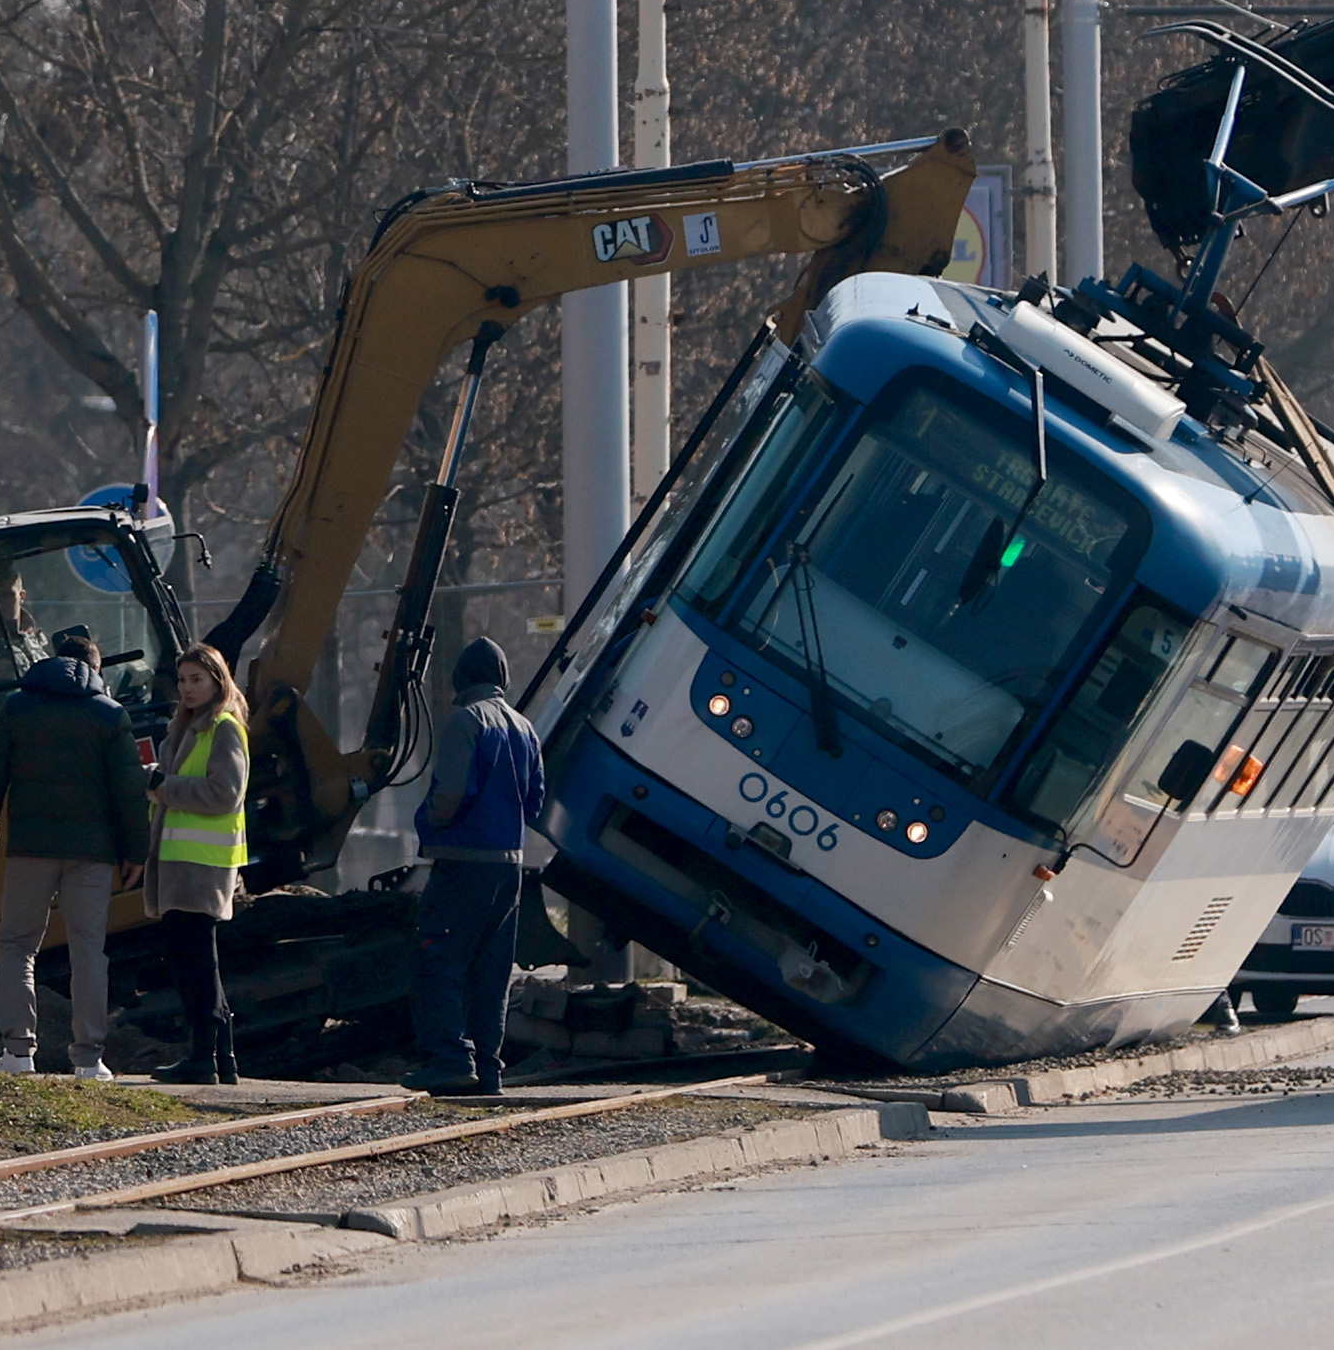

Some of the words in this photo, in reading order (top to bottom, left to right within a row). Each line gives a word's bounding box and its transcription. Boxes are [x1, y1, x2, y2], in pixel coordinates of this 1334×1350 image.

[593, 216, 651, 261] CAT
[1074, 356, 1113, 384] DOMETIC
[917, 407, 938, 439] 1
[739, 772, 840, 852] 0606
[1304, 928, 1323, 946] OS
